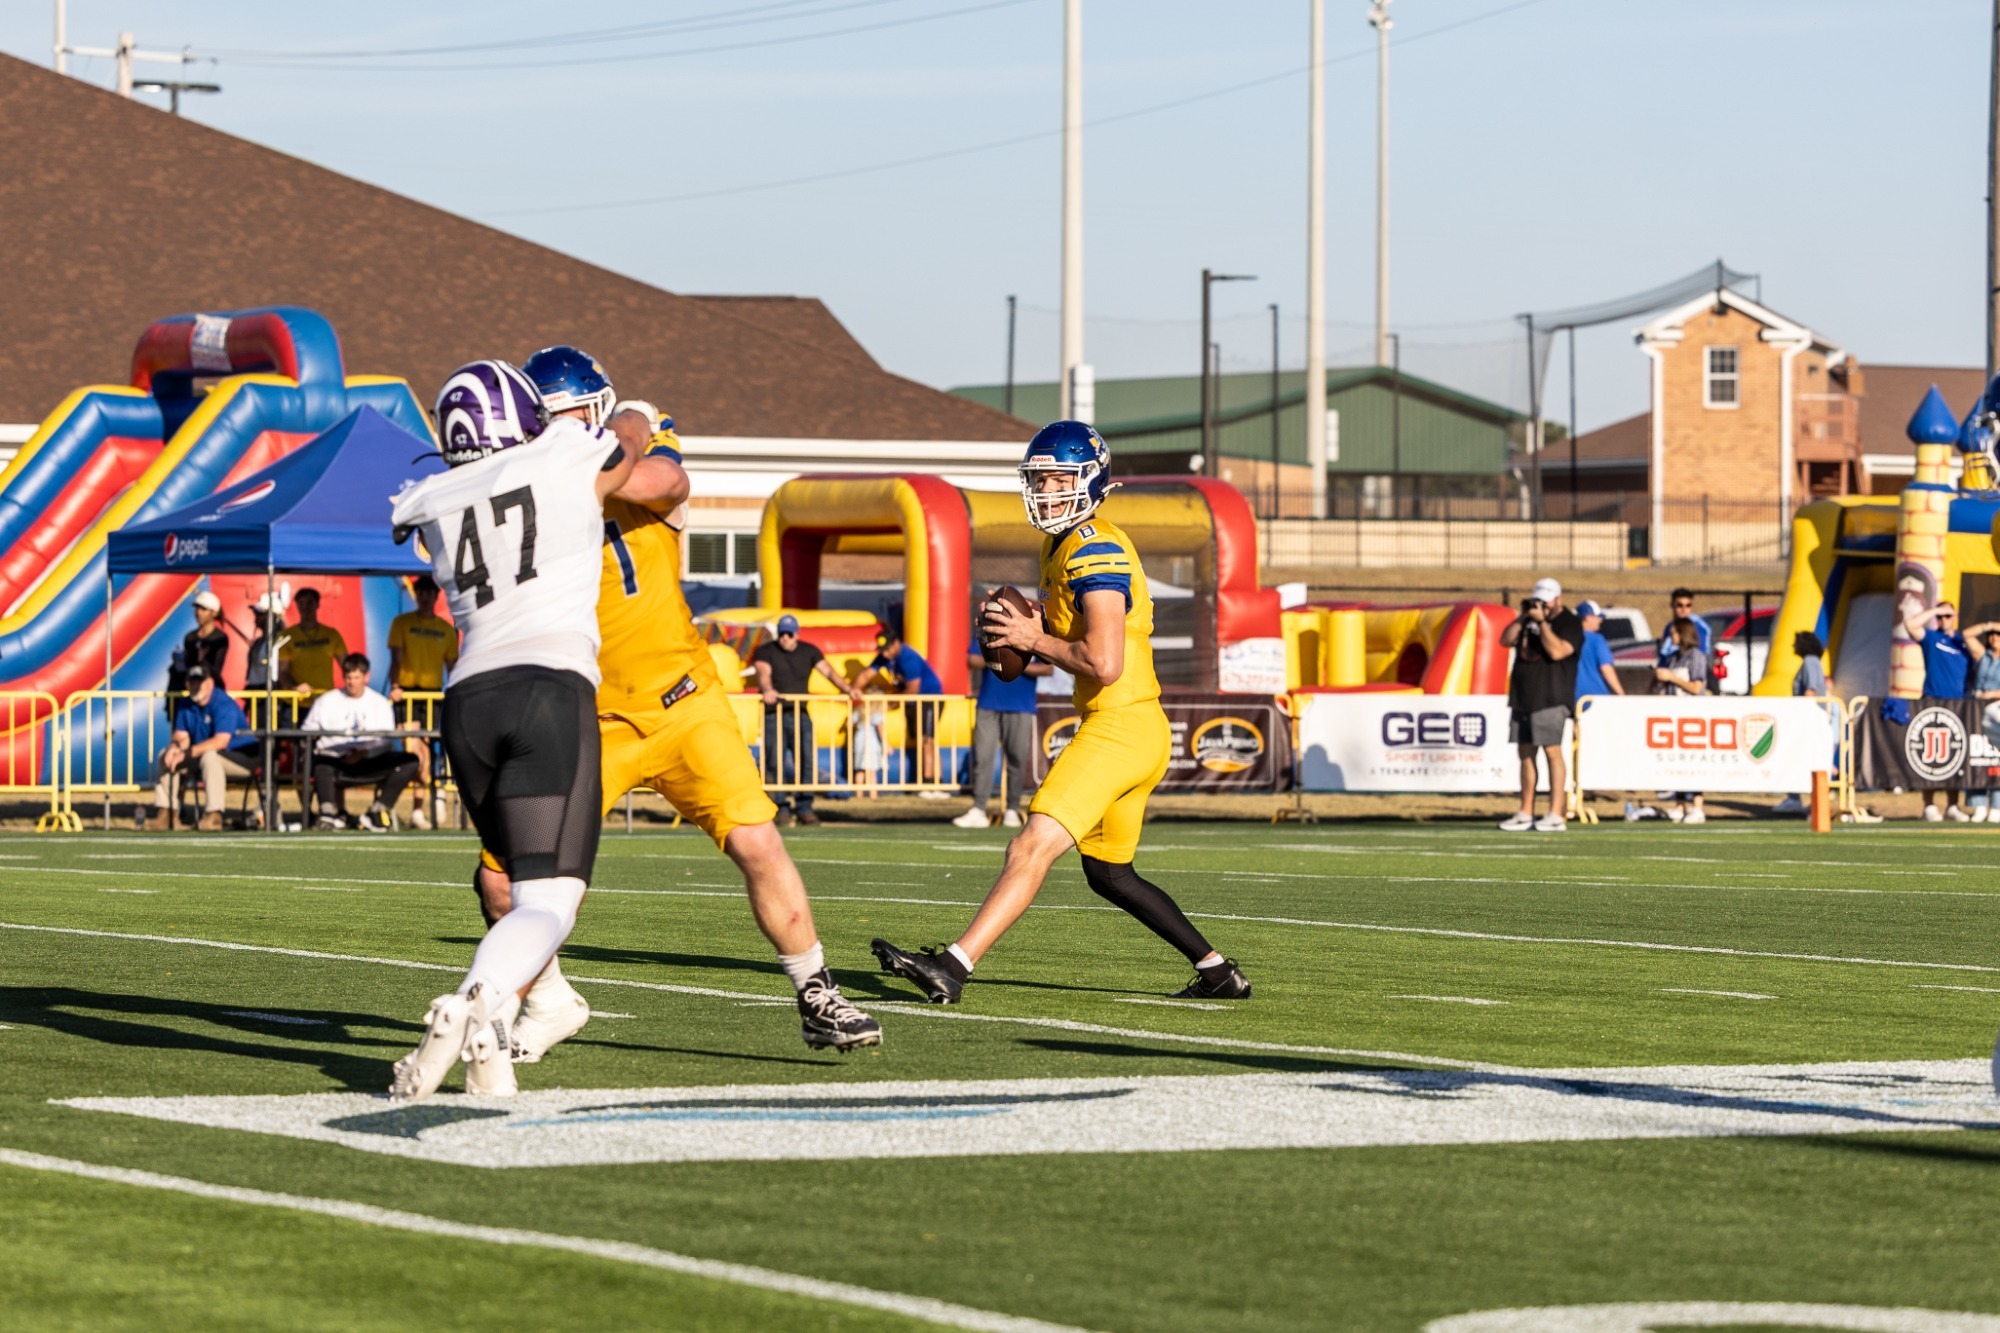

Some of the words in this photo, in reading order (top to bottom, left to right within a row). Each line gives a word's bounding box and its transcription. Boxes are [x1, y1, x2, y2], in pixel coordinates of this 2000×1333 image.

[179, 535, 209, 560] pepsi
[454, 484, 539, 610] 47
[1382, 712, 1486, 747] GEO
[1385, 752, 1425, 763] SPORT
[1428, 752, 1483, 763] LIGHTING
[1656, 753, 1739, 763] SURFACES
